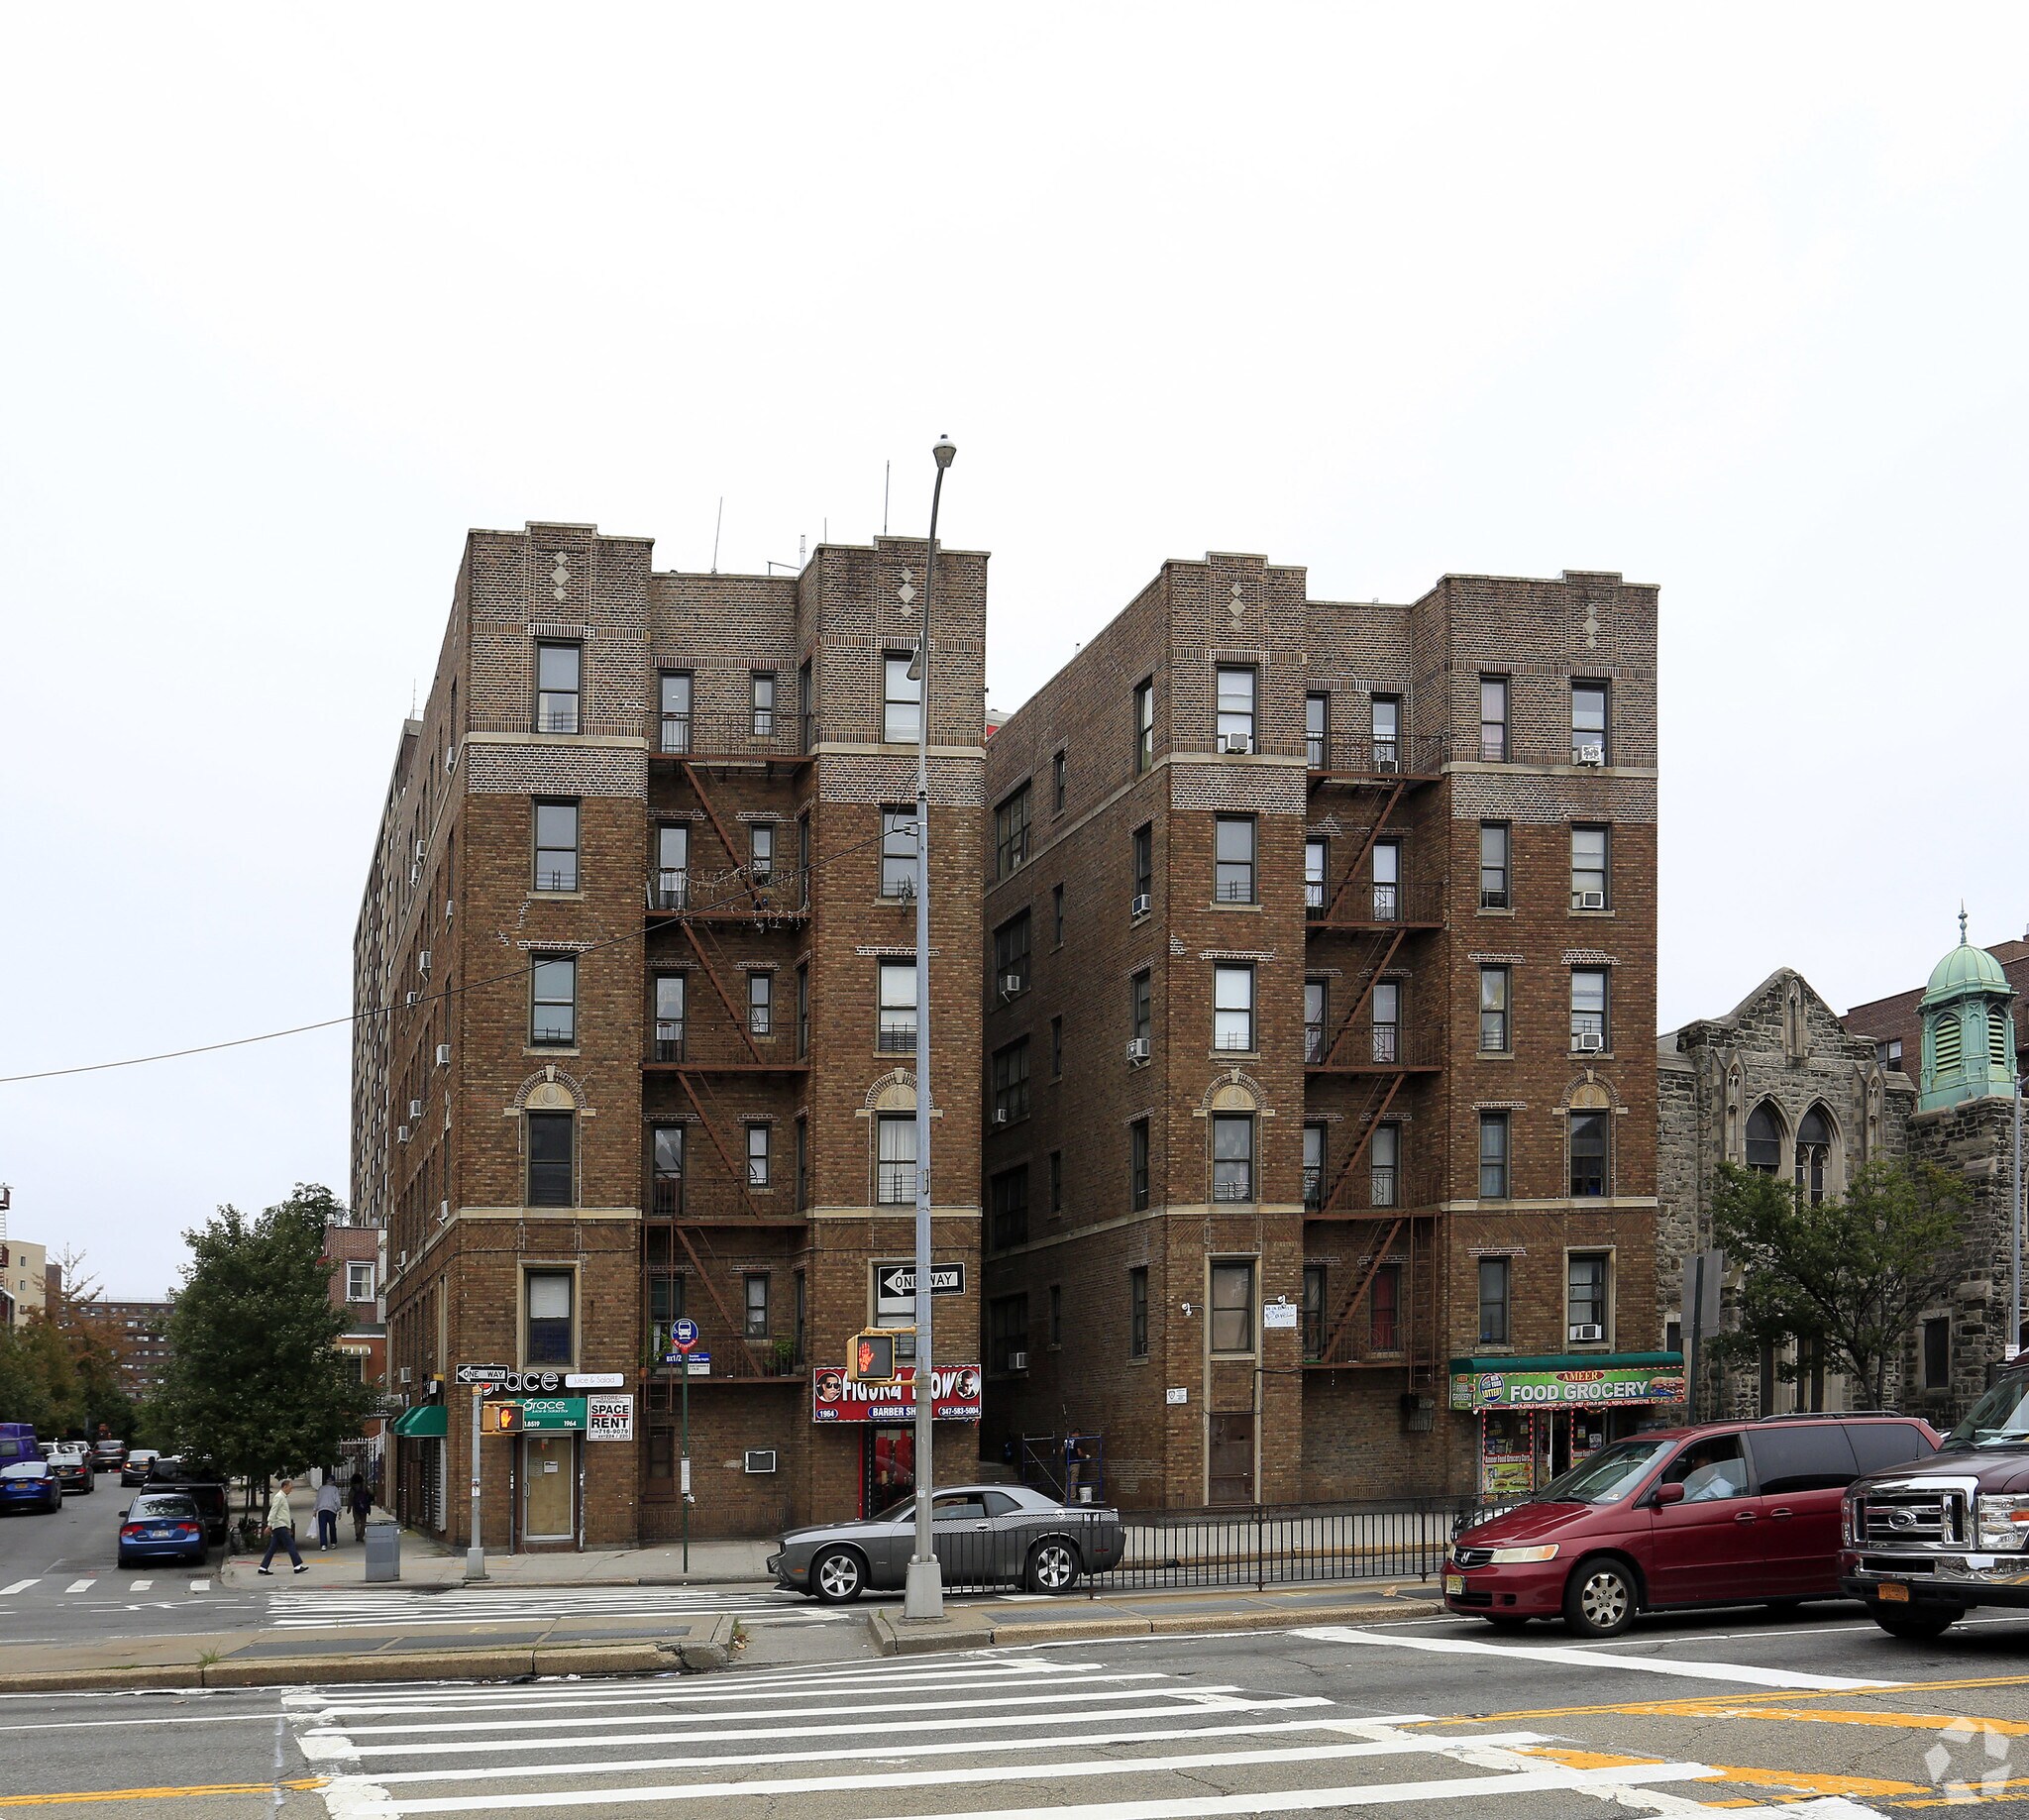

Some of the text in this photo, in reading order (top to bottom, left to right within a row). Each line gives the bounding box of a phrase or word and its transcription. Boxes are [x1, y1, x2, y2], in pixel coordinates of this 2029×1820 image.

[1562, 1371, 1598, 1381] AMEER
[1482, 1387, 1503, 1398] LOTTERY
[1510, 1384, 1559, 1402] FOOD
[1563, 1381, 1649, 1400] GROCERY
[523, 1399, 566, 1411] grace
[590, 1404, 629, 1414] SPACE
[873, 1407, 906, 1417] BARBER
[591, 1418, 629, 1429] RENT
[1497, 1454, 1507, 1463] Food
[1507, 1453, 1522, 1463] Grocery
